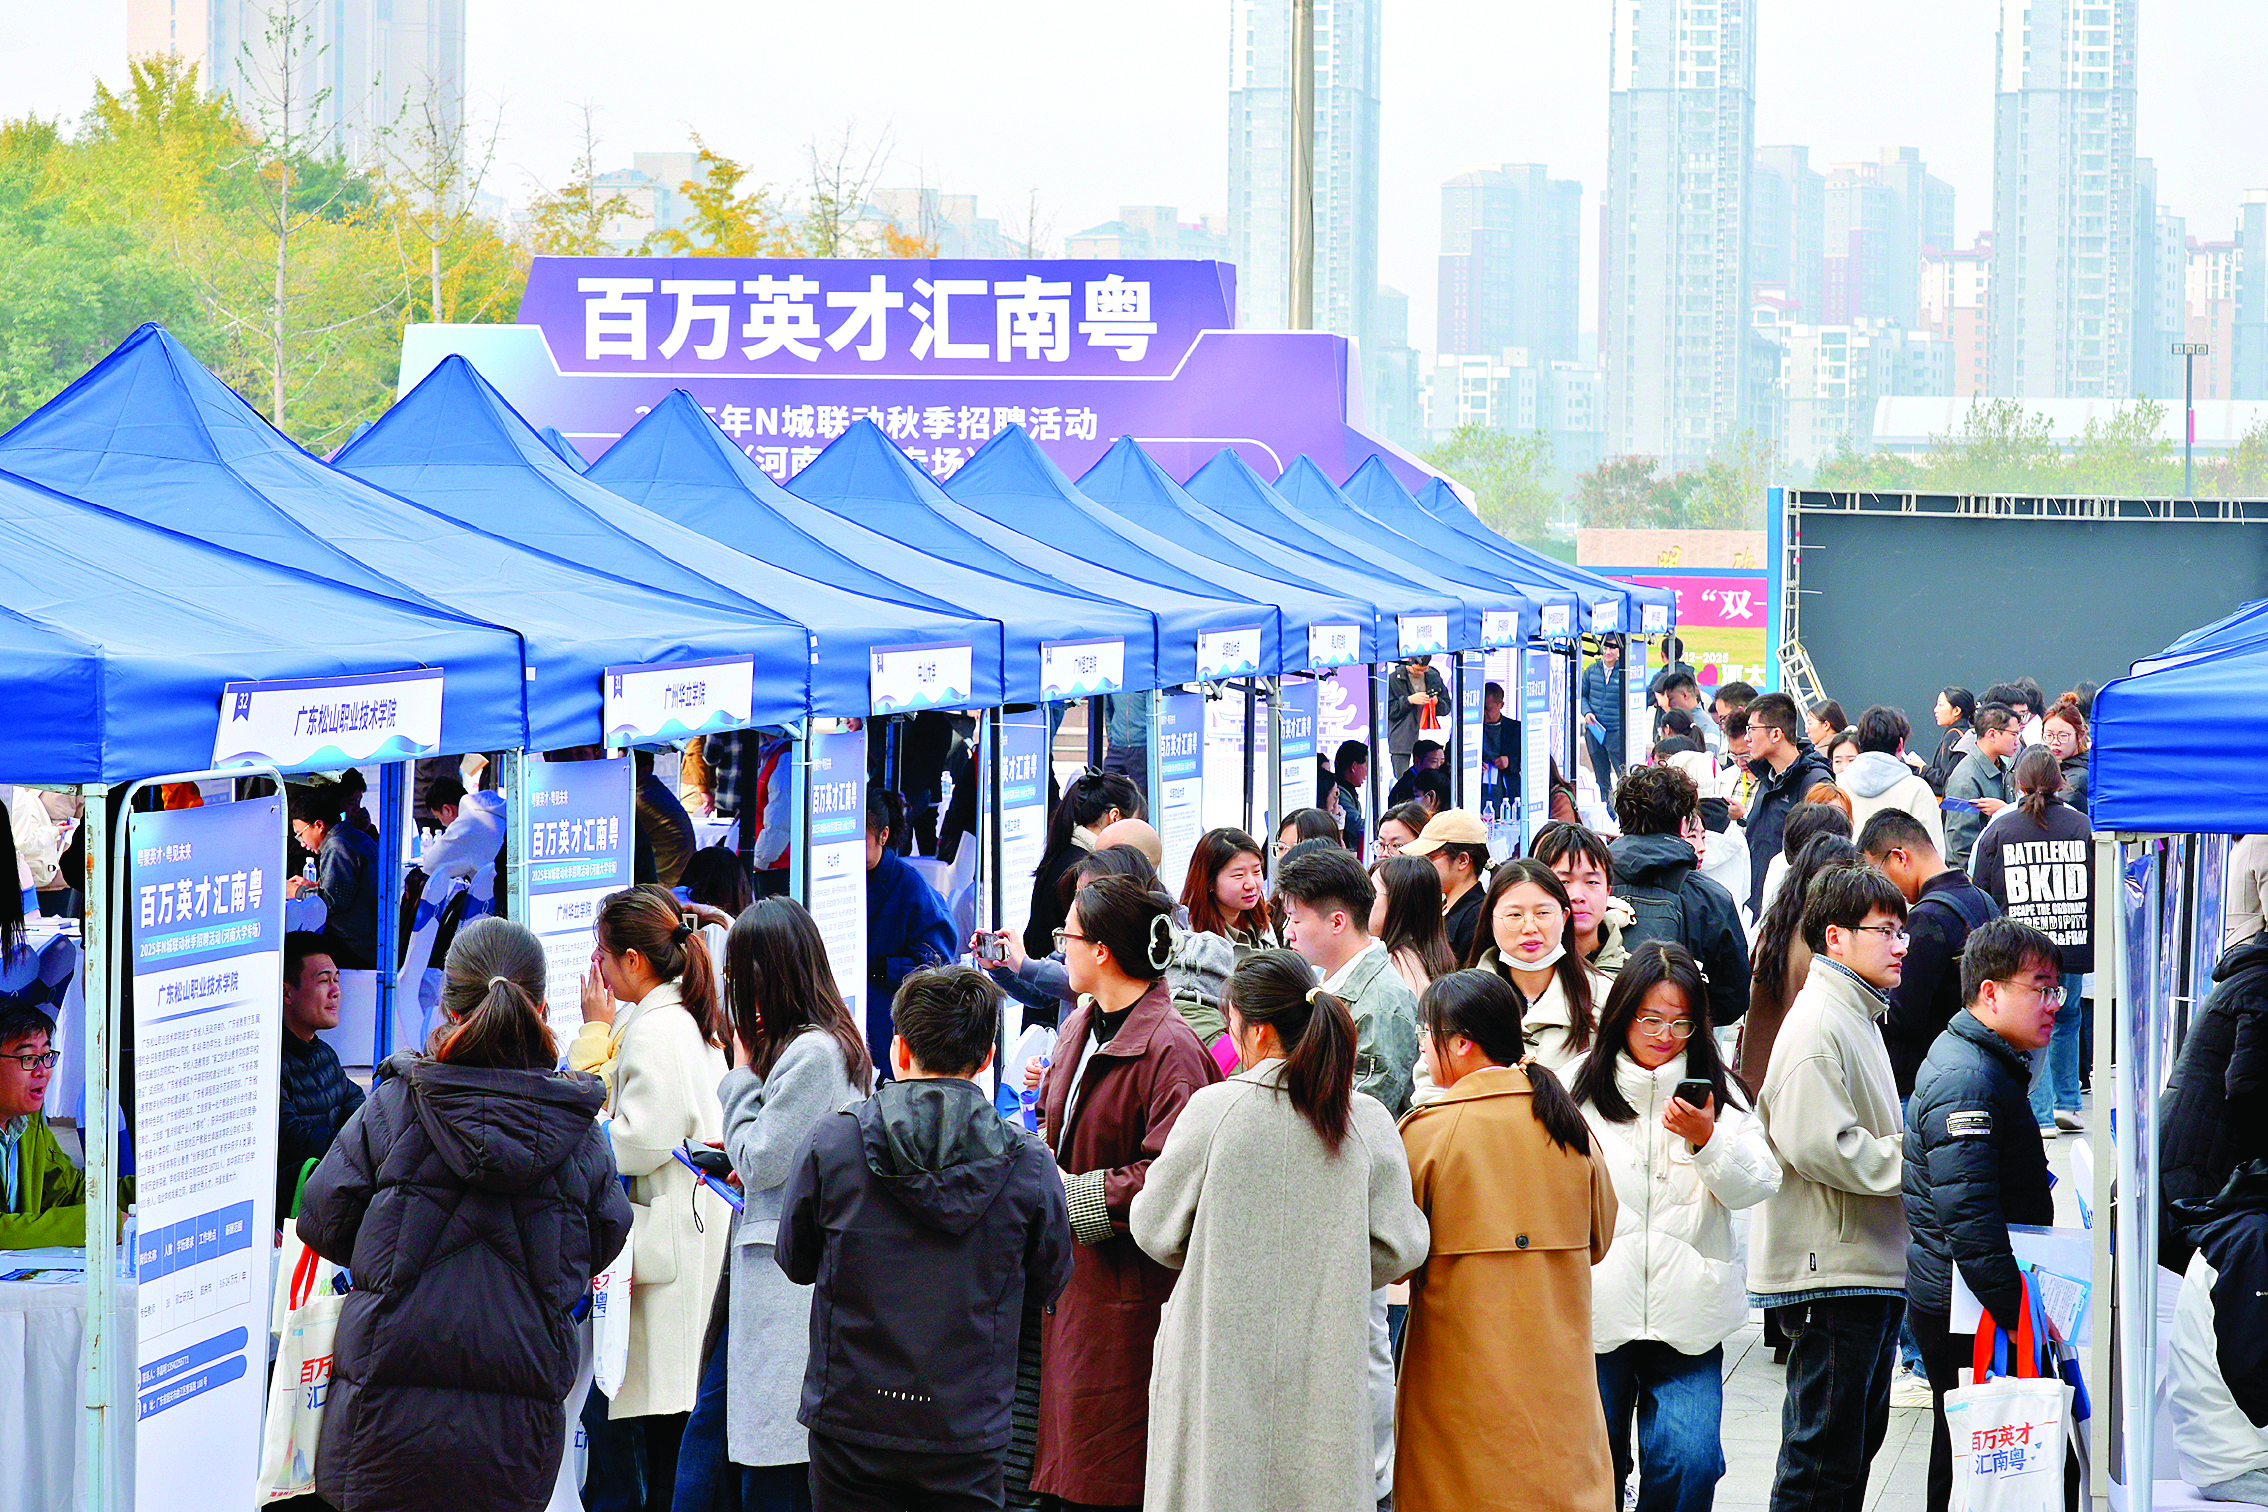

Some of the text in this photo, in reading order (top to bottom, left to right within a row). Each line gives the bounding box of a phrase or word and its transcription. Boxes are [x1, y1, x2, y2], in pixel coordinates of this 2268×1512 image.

[577, 273, 1157, 364] 百万英才汇南粤
[237, 692, 249, 710] 32
[664, 680, 706, 709] 广州华立学院
[293, 698, 397, 736] 广东松山职业技术学院
[812, 780, 857, 815] 百万英才汇南粤
[532, 816, 619, 858] 百万英才汇南粤
[2002, 840, 2086, 866] BATTLEKID
[140, 867, 263, 929] 百万英才汇南粤
[2004, 863, 2088, 904] BKID
[556, 901, 592, 922] 广州华立学院
[2036, 903, 2051, 916] THE
[157, 970, 239, 1007] 广东松山职业技术学院
[1972, 1422, 2034, 1452] 百万英才
[1975, 1447, 2027, 1475] 汇南粤
